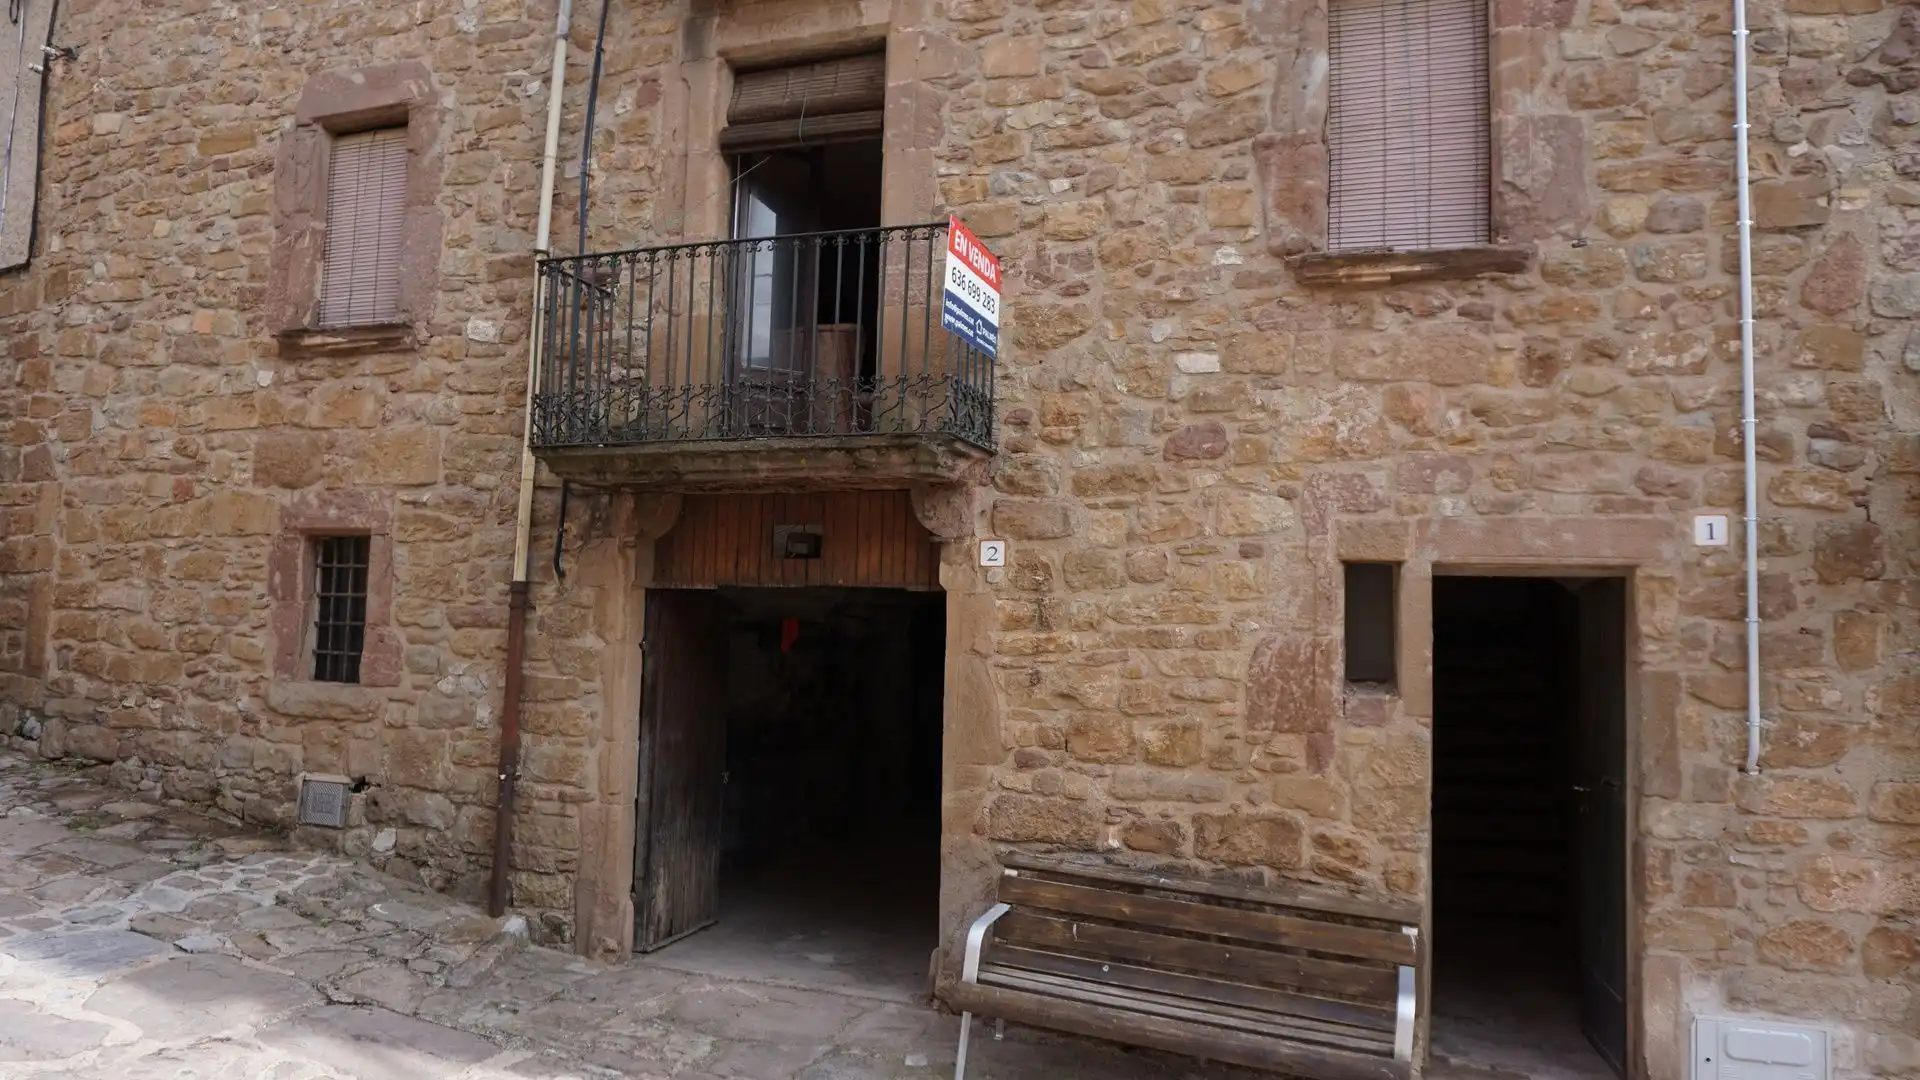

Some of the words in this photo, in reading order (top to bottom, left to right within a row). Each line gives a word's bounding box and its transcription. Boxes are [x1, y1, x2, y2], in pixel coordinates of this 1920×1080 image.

[954, 229, 968, 257] EN
[968, 241, 997, 284] VENDA
[951, 267, 966, 291] 636
[967, 280, 981, 302] 699
[982, 291, 996, 314] 283
[1706, 522, 1717, 541] 1
[986, 546, 999, 562] 2
